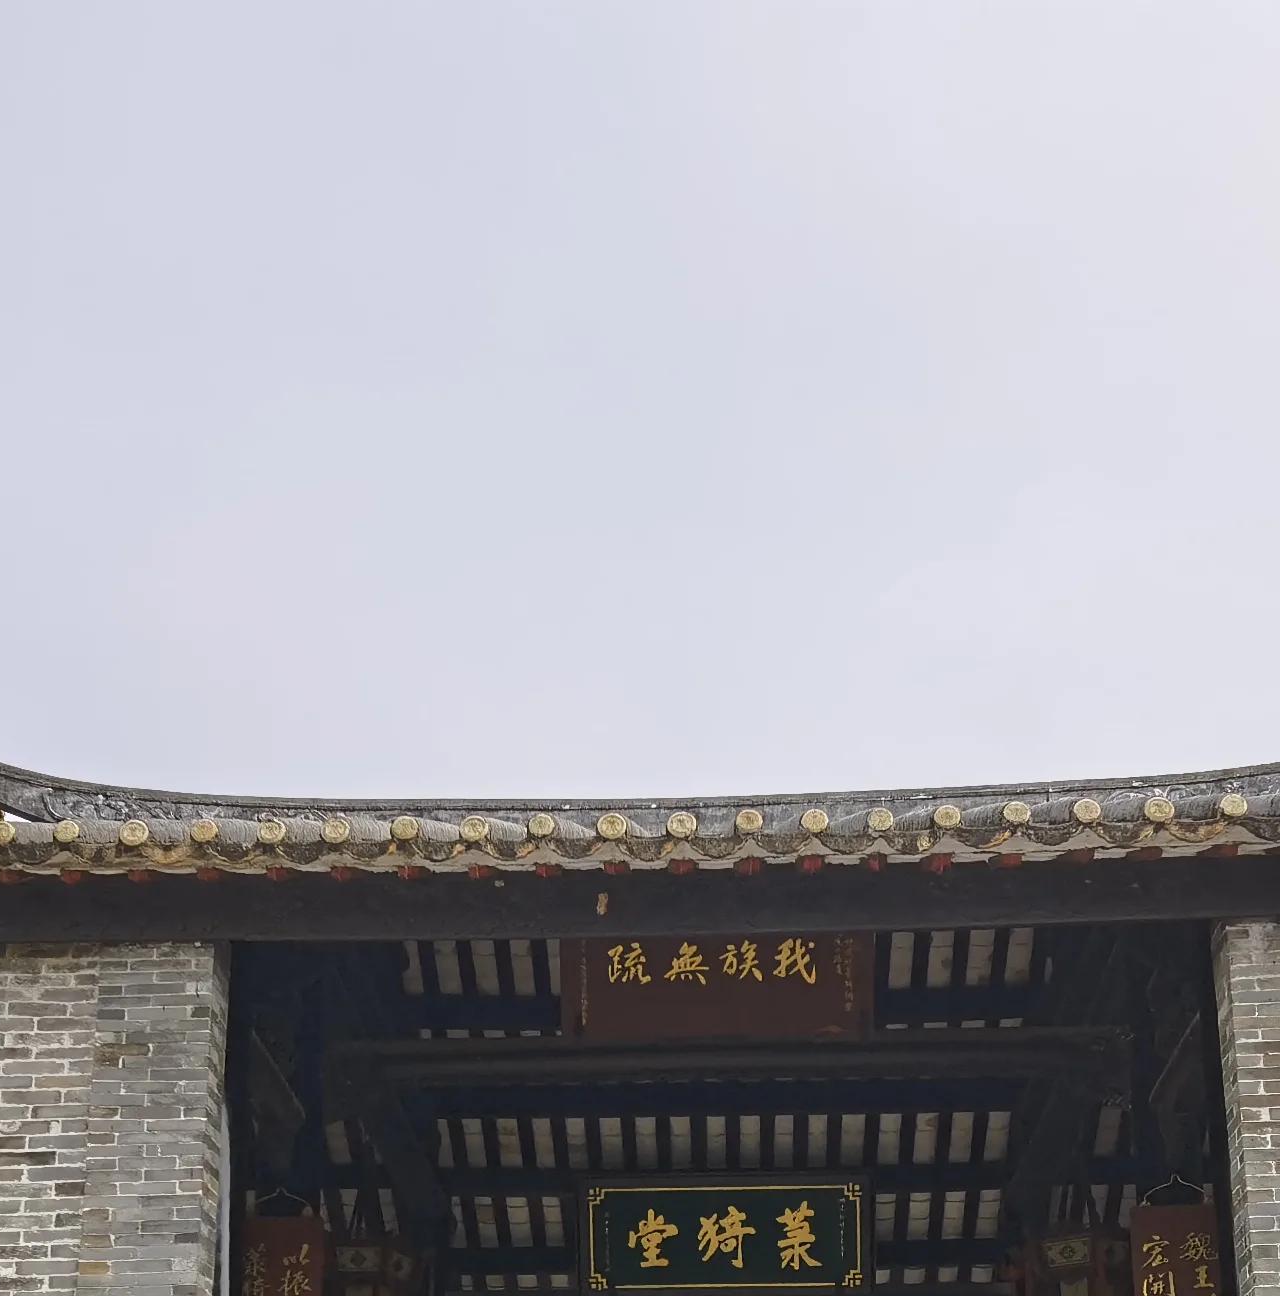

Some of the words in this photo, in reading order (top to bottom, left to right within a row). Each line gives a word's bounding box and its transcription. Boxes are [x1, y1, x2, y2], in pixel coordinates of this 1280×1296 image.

[606, 936, 818, 986] 我族無疏
[627, 1200, 823, 1271] 菉猗堂
